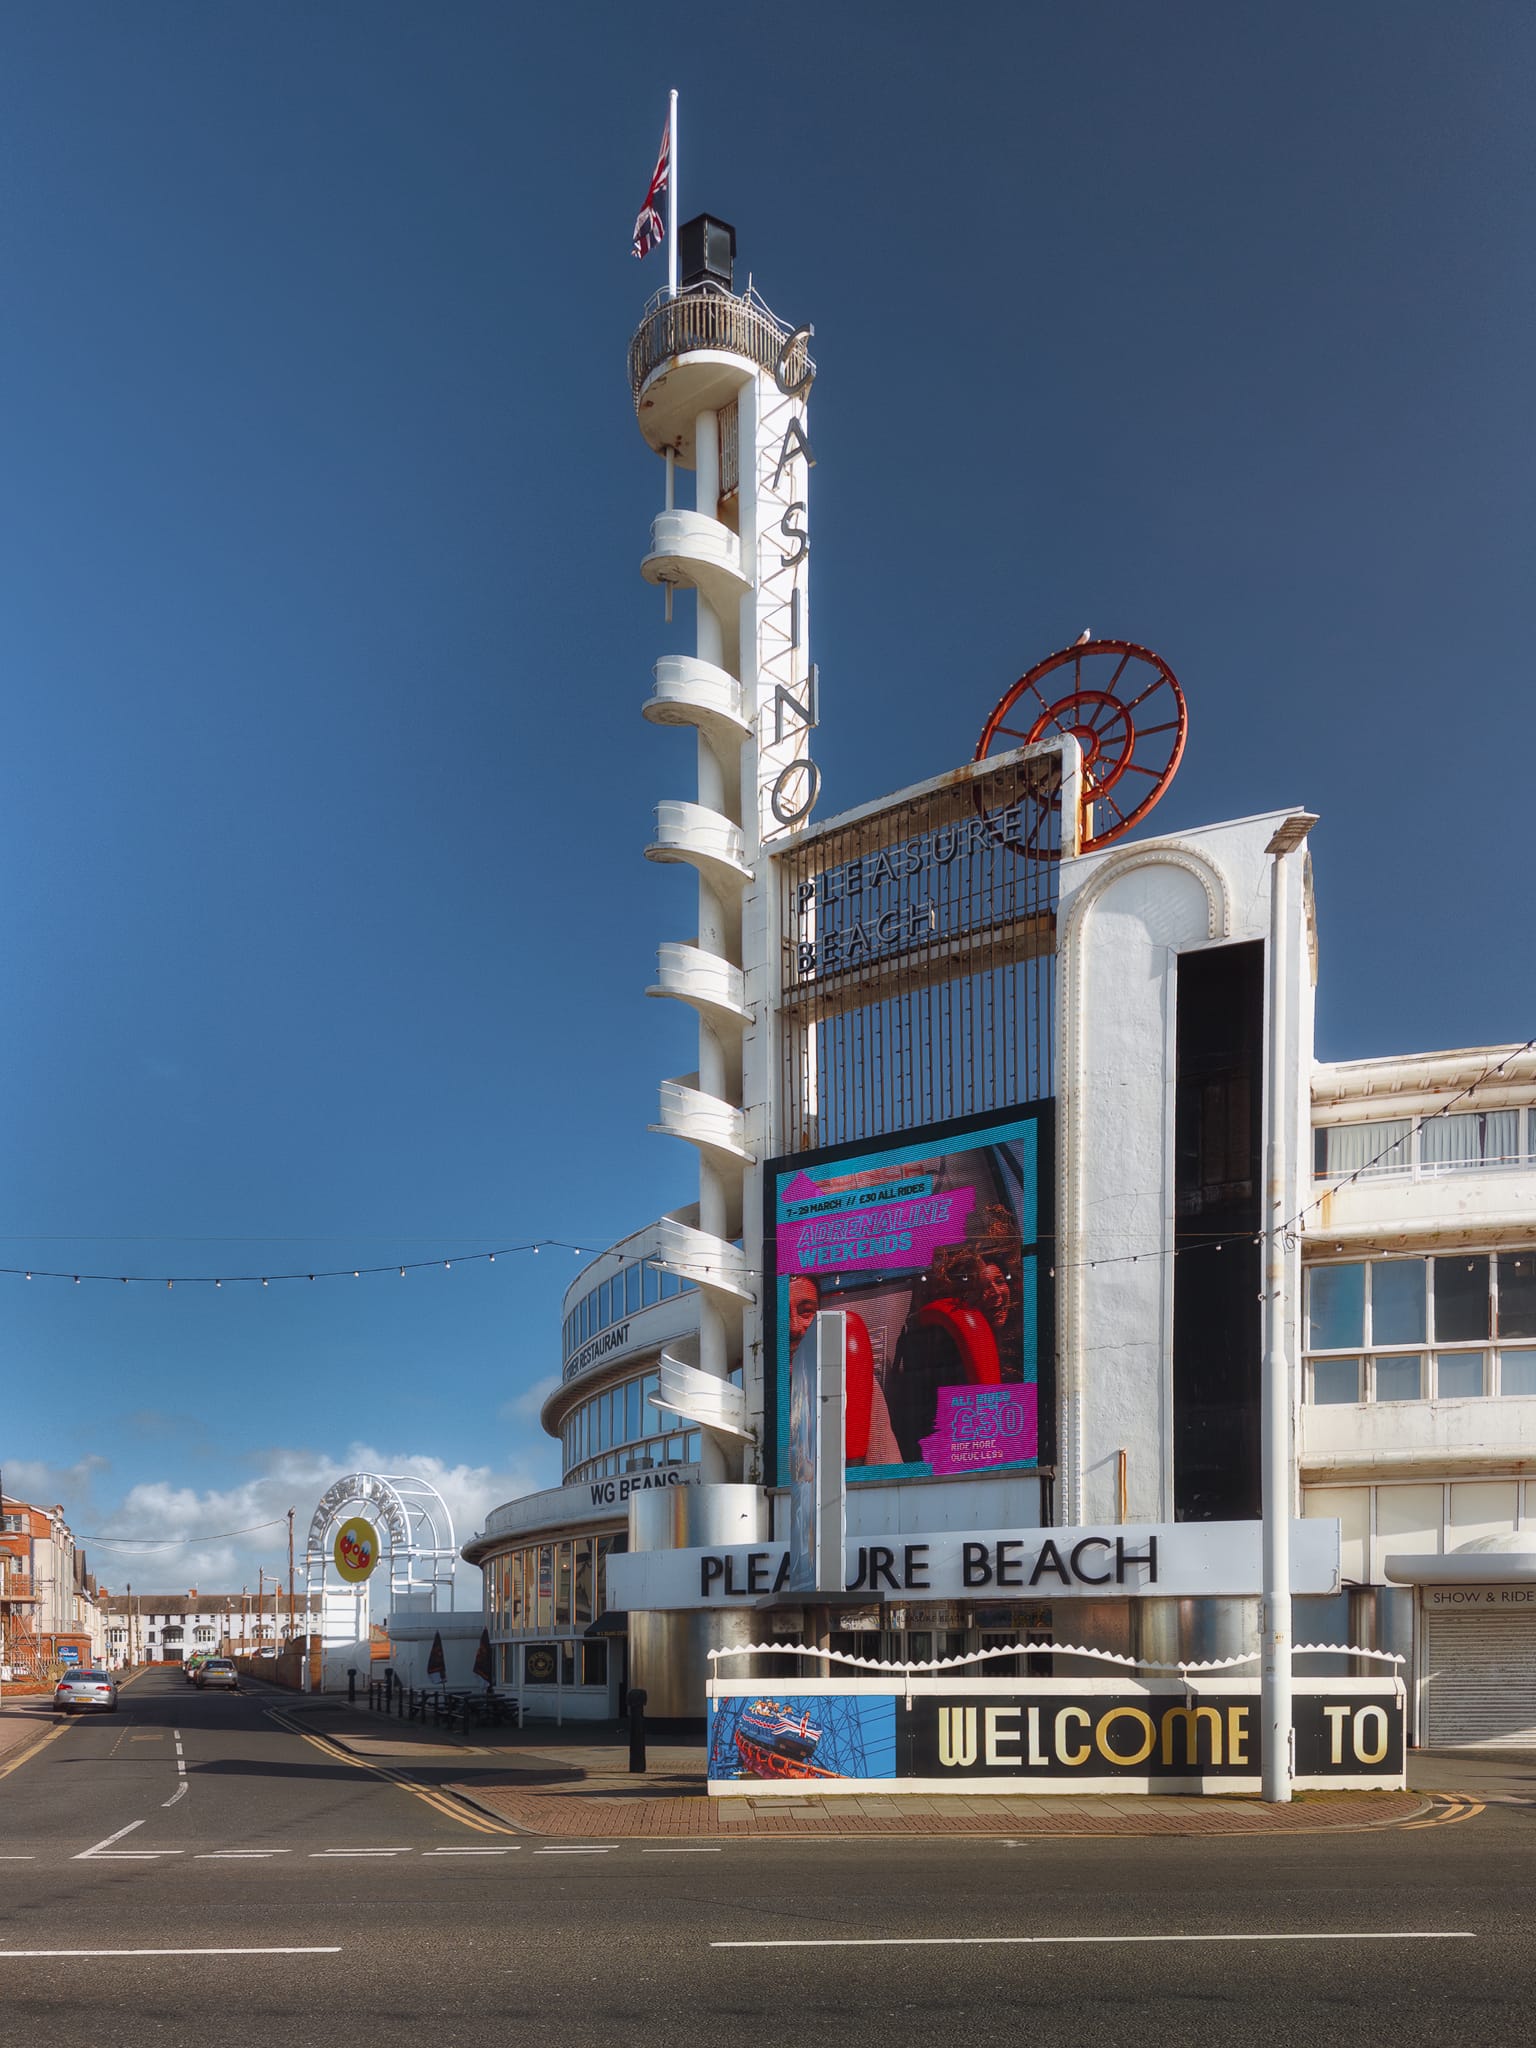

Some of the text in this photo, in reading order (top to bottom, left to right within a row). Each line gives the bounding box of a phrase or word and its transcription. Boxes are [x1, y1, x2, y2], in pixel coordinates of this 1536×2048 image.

[772, 322, 820, 827] CASINO
[797, 808, 1022, 915] PLEASURE
[797, 899, 936, 975] BEACH
[810, 1201, 841, 1213] MARCH
[878, 1189, 896, 1201] ALL
[897, 1183, 925, 1197] RIDES
[797, 1199, 953, 1248] ADRENALINE
[799, 1232, 912, 1268] WEEKENDS
[579, 1322, 630, 1370] RESTAURANT
[951, 1395, 974, 1407] ALL
[951, 1402, 1024, 1442] £30
[951, 1440, 997, 1452] RIDE MORE
[590, 1481, 615, 1506] WG
[701, 1535, 1158, 1597] PLEAURE BEACH
[1433, 1591, 1534, 1604] SHOW & RIDE
[938, 1705, 1389, 1767] WELCOME TO
